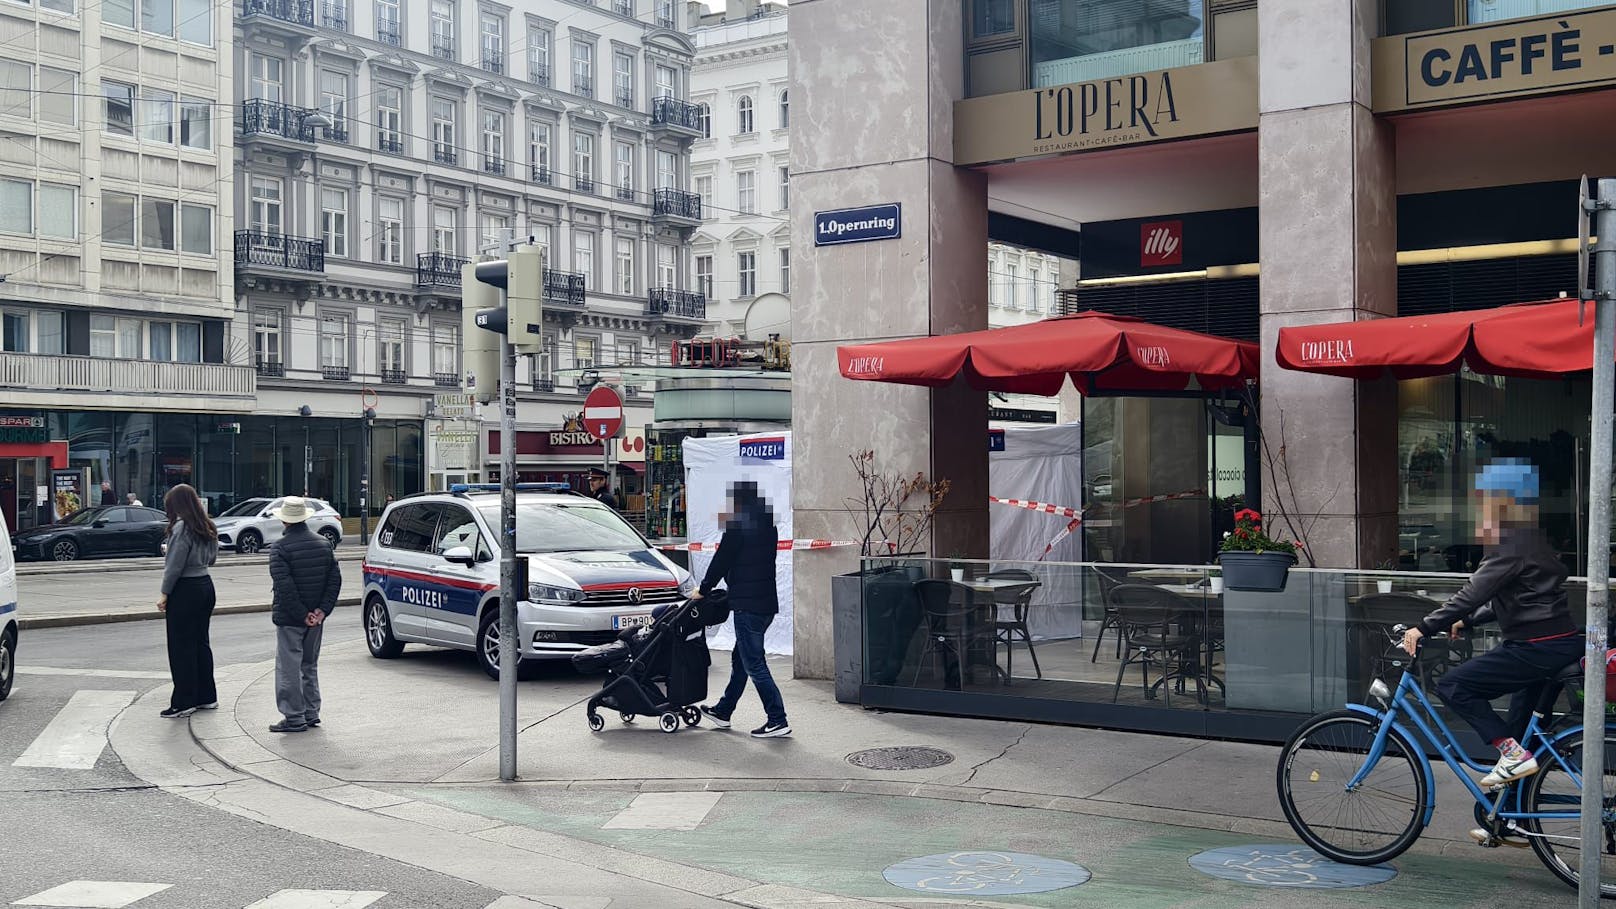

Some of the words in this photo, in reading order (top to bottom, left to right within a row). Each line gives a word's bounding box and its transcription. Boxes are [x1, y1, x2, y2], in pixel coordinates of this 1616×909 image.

[1420, 20, 1582, 88] CAFFÈ
[1033, 71, 1181, 141] L'OPERA
[1144, 227, 1179, 259] illy
[1301, 339, 1354, 363] L'OPERA
[740, 444, 777, 458] POLIZEI
[402, 586, 442, 608] POLIZEI
